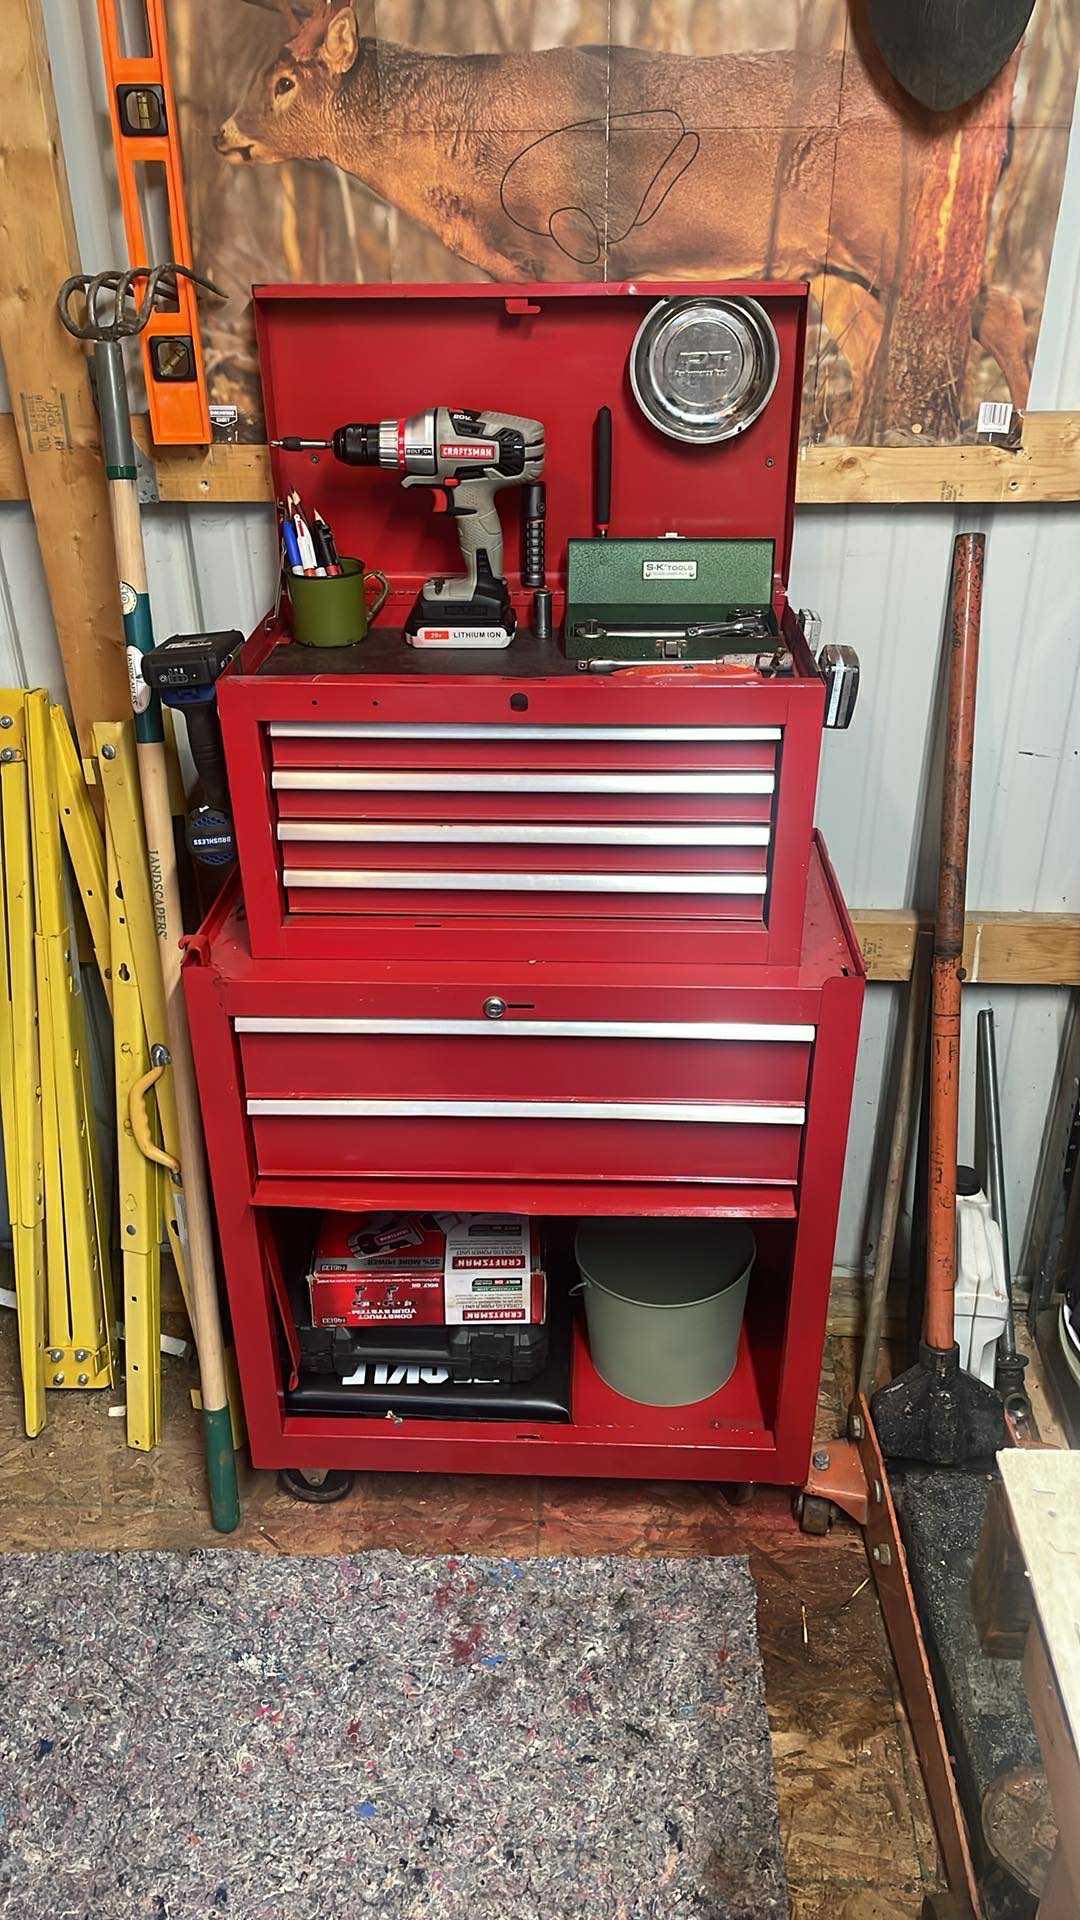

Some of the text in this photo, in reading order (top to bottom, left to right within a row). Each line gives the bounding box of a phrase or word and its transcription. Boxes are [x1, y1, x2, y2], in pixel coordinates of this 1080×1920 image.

[442, 447, 492, 457] CRAFTSMAN
[453, 631, 502, 639] LITHIUM ION
[193, 836, 231, 846] BRUSHLESS
[458, 1259, 522, 1267] CRAFTSMAN
[467, 1311, 522, 1319] CRAFTSMAN
